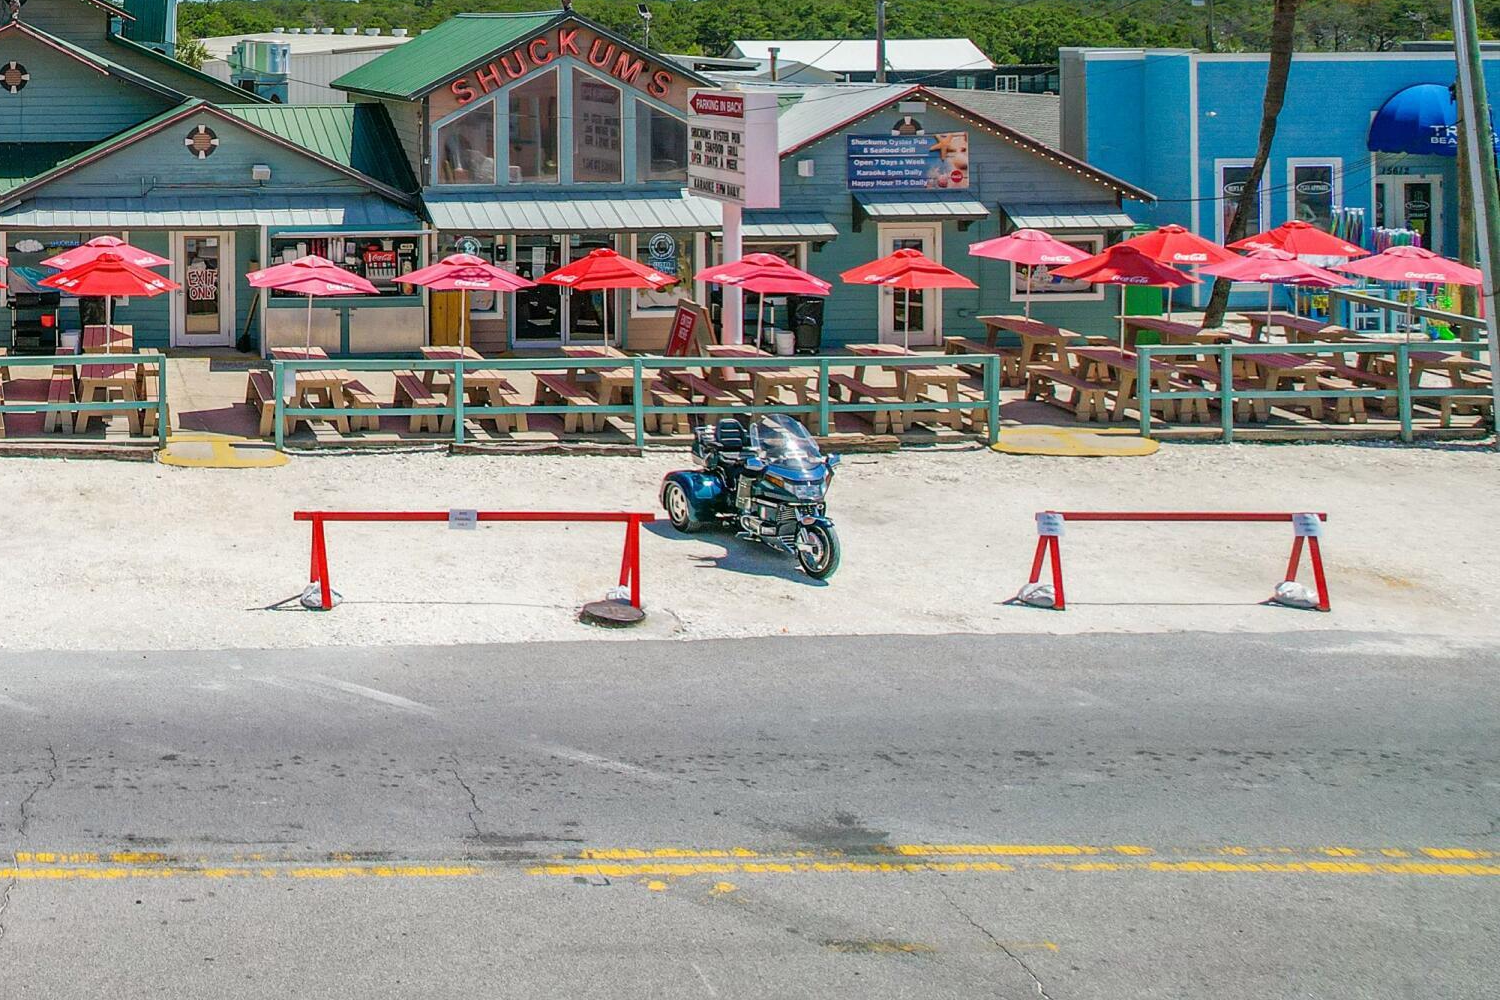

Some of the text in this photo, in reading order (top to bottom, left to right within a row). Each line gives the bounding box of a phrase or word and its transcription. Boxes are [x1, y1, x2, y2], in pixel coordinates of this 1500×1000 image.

[696, 98, 743, 114] PARKING IN BACK
[889, 139, 912, 147] Oyster
[905, 169, 922, 177] Daily
[910, 179, 928, 187] Daily
[188, 269, 218, 287] EXIT
[190, 286, 218, 300] ONLY
